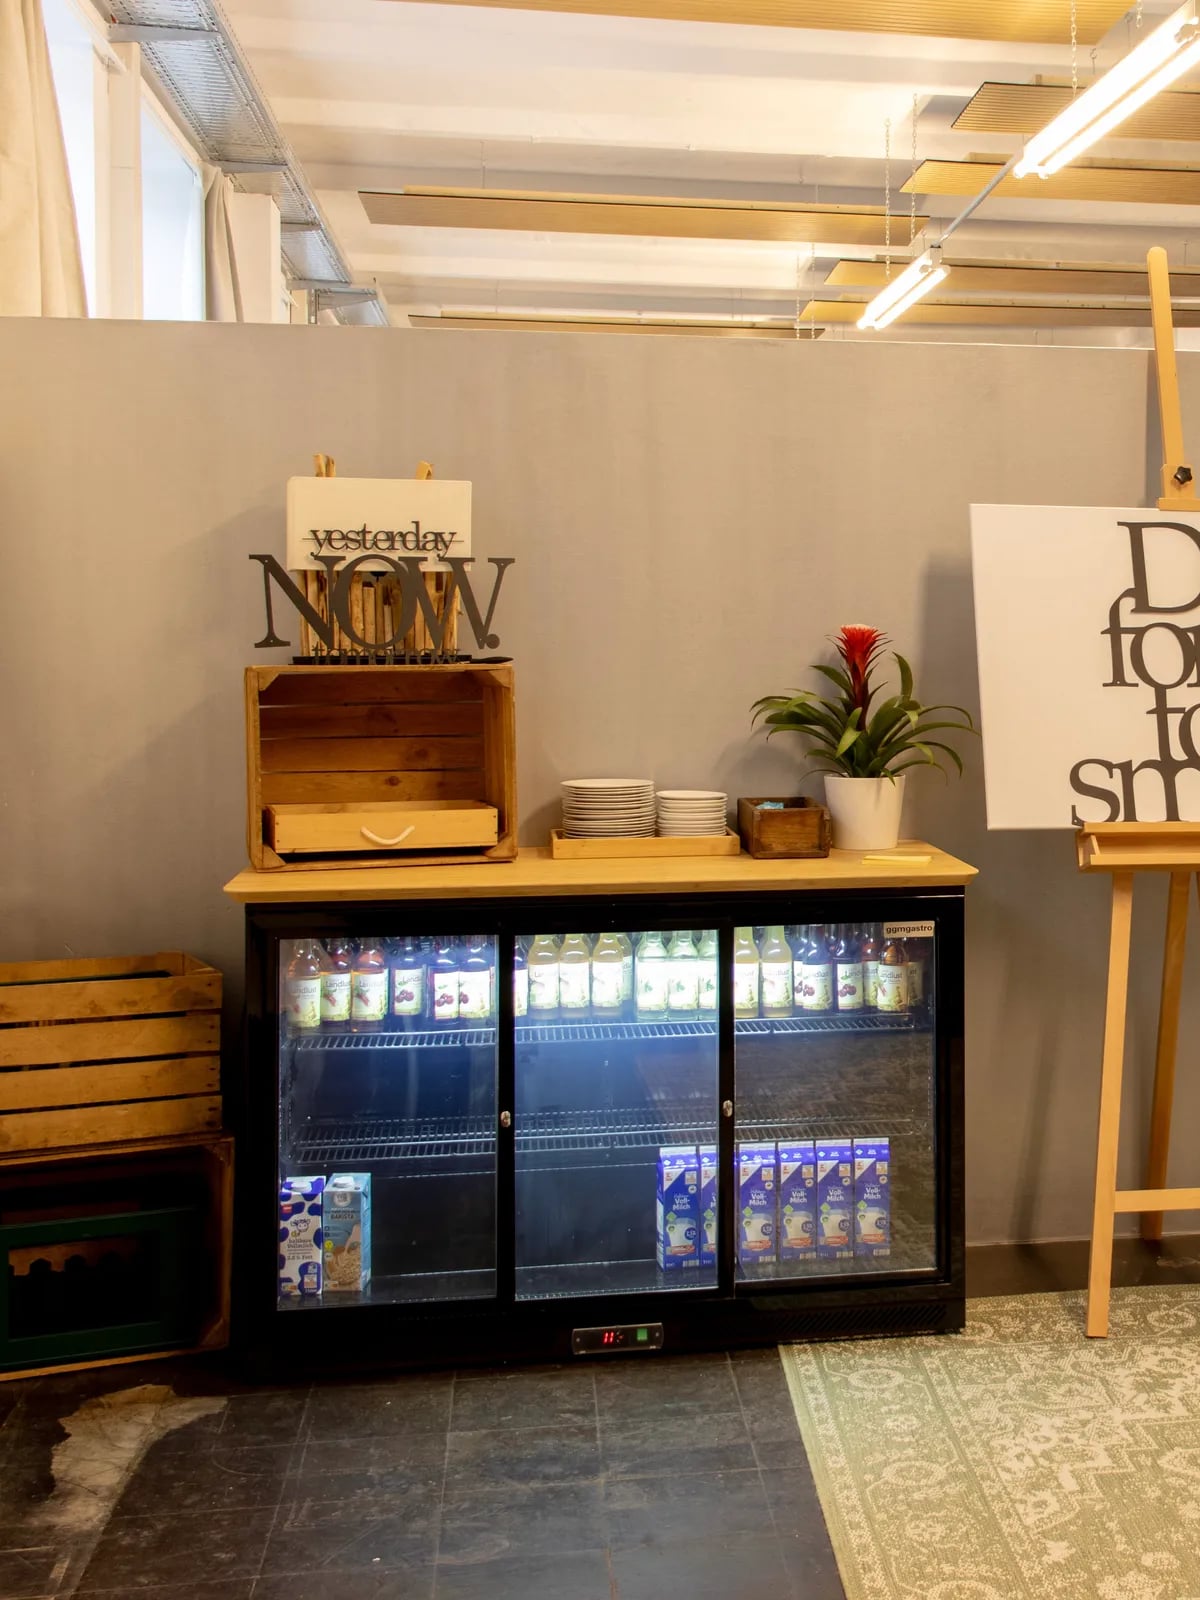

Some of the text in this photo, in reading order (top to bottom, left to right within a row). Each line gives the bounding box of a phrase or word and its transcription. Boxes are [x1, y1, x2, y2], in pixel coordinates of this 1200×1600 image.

[310, 520, 457, 559] yesterday
[885, 924, 933, 935] ggmgastro
[672, 1203, 691, 1211] Milch
